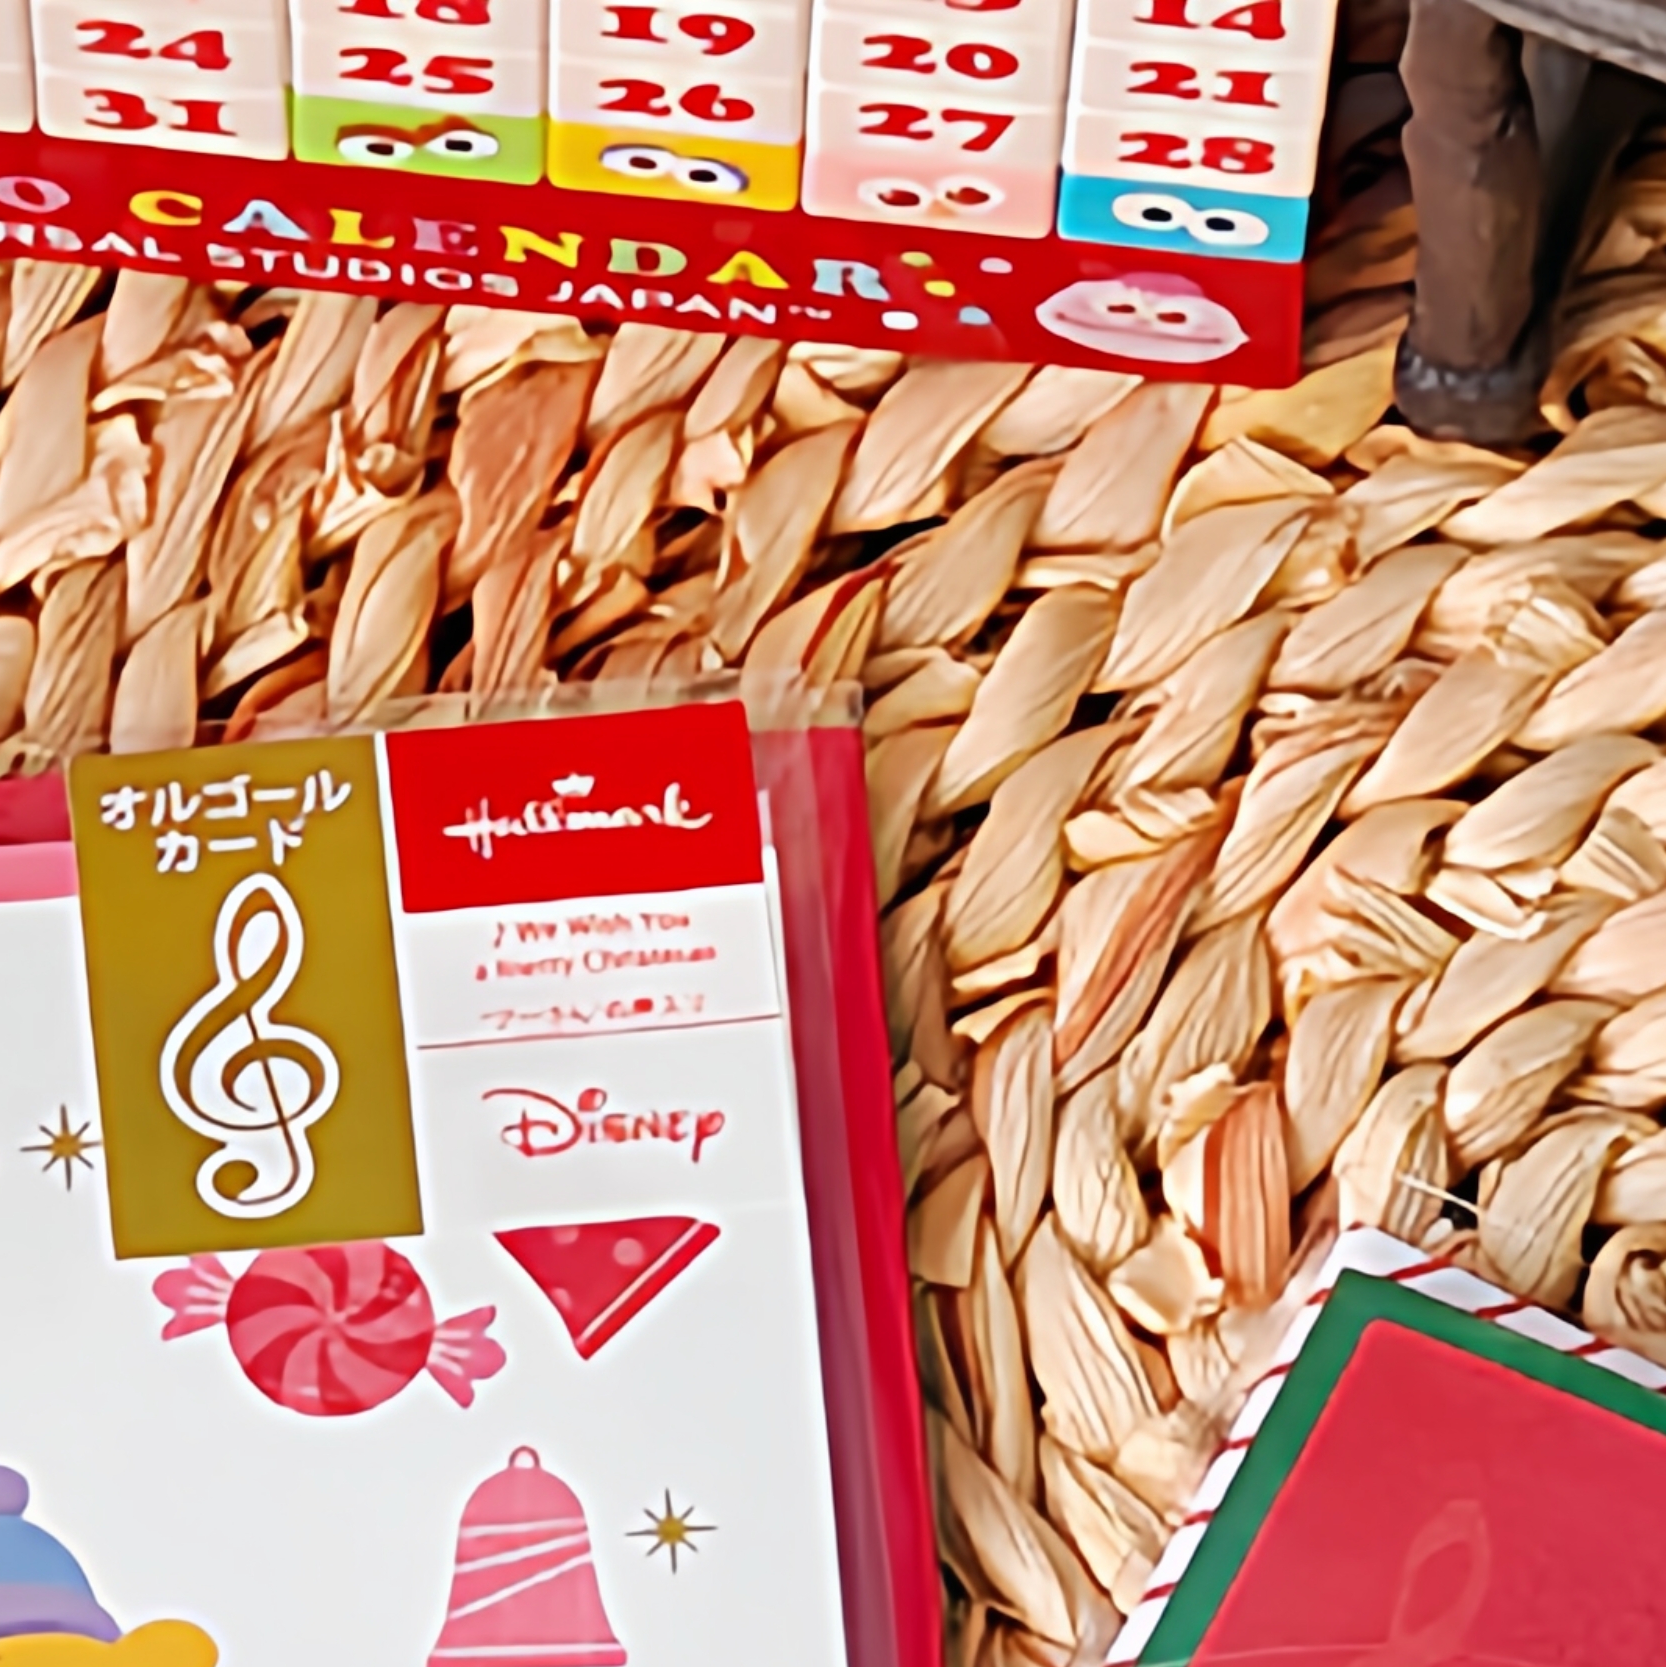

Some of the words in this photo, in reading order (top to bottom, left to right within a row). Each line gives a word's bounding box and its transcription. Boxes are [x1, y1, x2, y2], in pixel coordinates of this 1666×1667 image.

[600, 5, 755, 56] 19
[861, 33, 1018, 79] 20
[1126, 61, 1280, 108] 21
[76, 20, 231, 71] 24
[339, 47, 494, 94] 25
[599, 78, 755, 122] 26
[858, 103, 1016, 152] 27
[1118, 131, 1275, 174] 28
[84, 88, 237, 136] 31
[129, 190, 889, 300] CALENDAR
[207, 243, 519, 297] STUDIOS
[100, 769, 351, 830] オルゴール
[442, 783, 713, 859] Hallmark
[156, 814, 303, 873] カード
